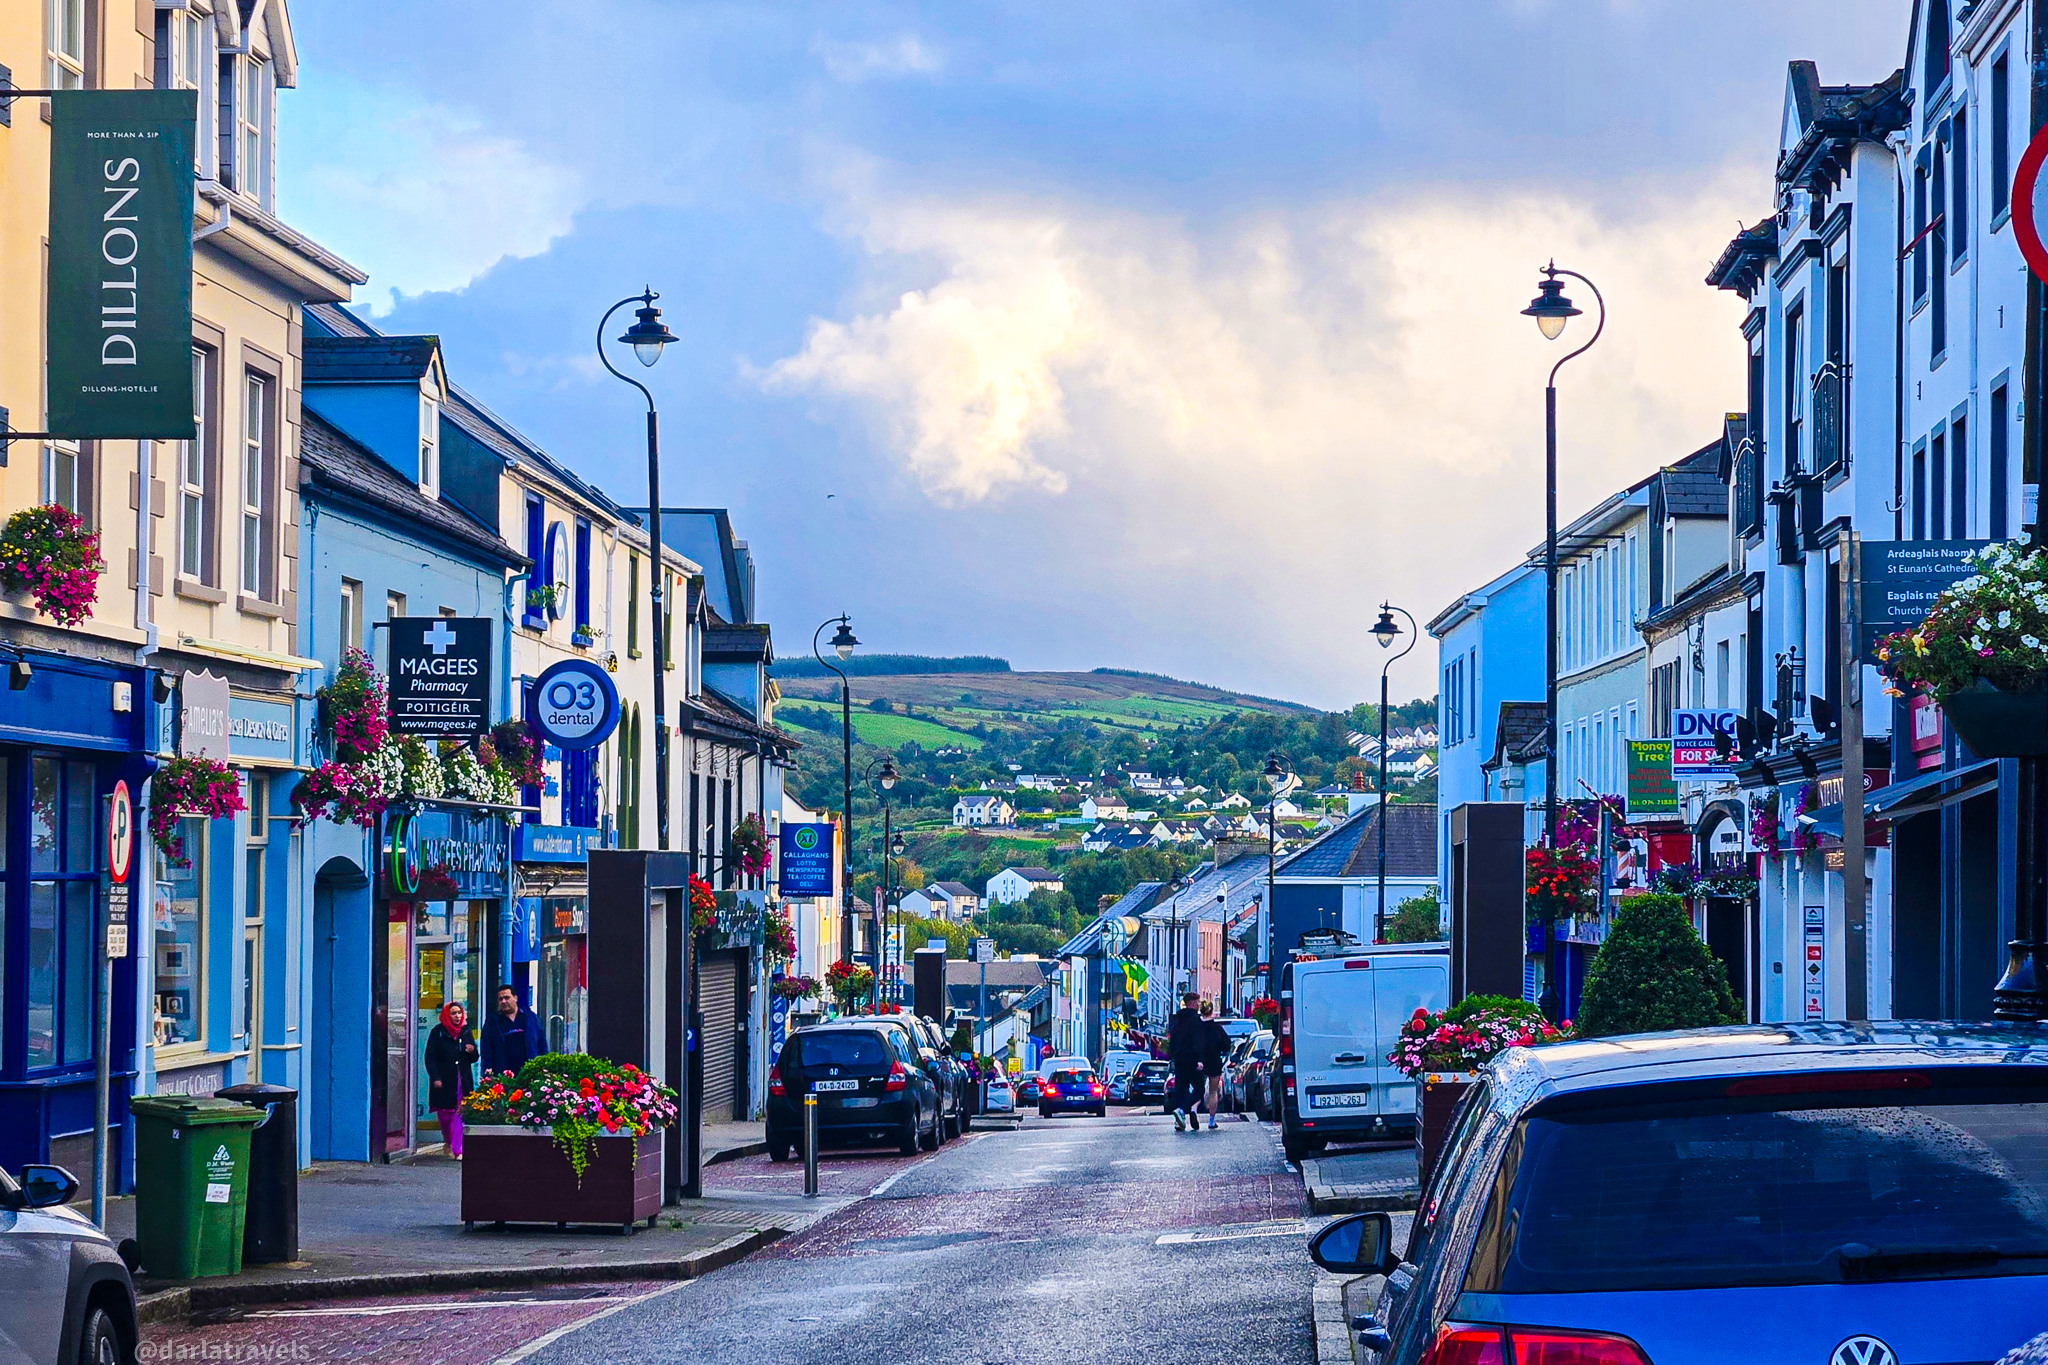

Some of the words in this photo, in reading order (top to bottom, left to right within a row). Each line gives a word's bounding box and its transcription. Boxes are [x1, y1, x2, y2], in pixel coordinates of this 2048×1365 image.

[102, 157, 140, 365] DILLONS
[1887, 549, 1939, 559] Ardeaglais
[1888, 565, 1897, 573] St
[1899, 565, 1933, 573] Eunan's
[1888, 591, 1924, 602] Eaglais
[1888, 606, 1923, 615] Church
[400, 658, 478, 675] MAGEES
[411, 679, 468, 695] Pharmacy
[547, 681, 596, 710] O3
[406, 702, 470, 713] POITIGÉIR
[548, 711, 594, 725] dental
[1678, 713, 1736, 735] DNG
[400, 720, 477, 731] www.magees.ie
[1631, 742, 1670, 752] Money
[1637, 752, 1665, 761] Tree
[1681, 750, 1702, 761] FOR
[116, 800, 127, 864] P
[463, 842, 506, 873] PHARMACY
[194, 1074, 217, 1094] CRAFTS
